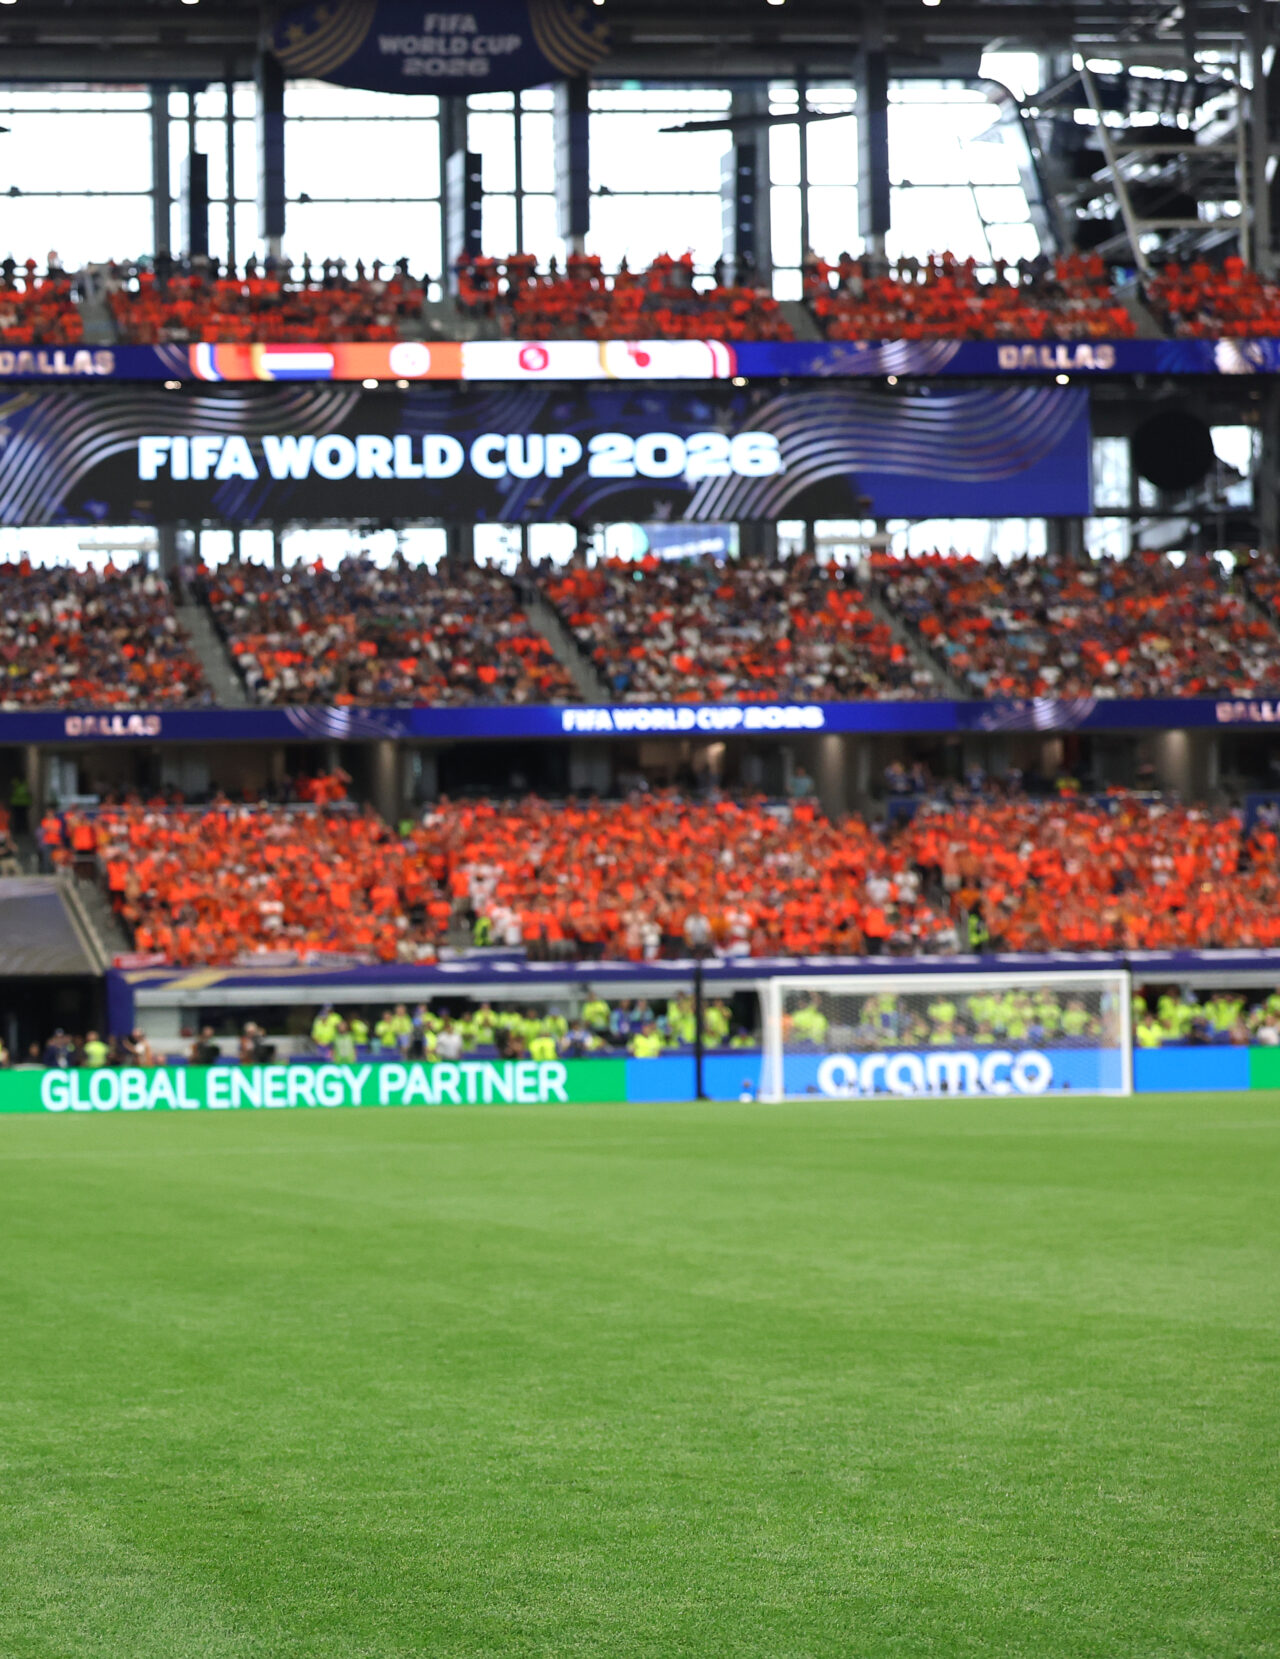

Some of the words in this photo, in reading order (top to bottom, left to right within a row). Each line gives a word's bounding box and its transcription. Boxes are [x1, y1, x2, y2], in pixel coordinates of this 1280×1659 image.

[424, 13, 477, 33] FIFA
[378, 35, 468, 55] WORLD
[472, 33, 522, 55] CUP
[402, 57, 489, 76] 2026
[997, 344, 1116, 370] DALLAS
[138, 435, 258, 480] FIFA
[263, 434, 464, 480] WORLD
[470, 433, 582, 478] CUP
[588, 432, 782, 478] 2026
[562, 708, 613, 731] FIFA
[613, 707, 696, 731] WORLD
[696, 706, 744, 730] CUP
[1215, 701, 1280, 723] DALL
[41, 1067, 200, 1112] GLOBAL
[206, 1064, 372, 1108] ENERGY
[378, 1060, 568, 1105] PARTNER
[817, 1050, 1053, 1098] aramco
